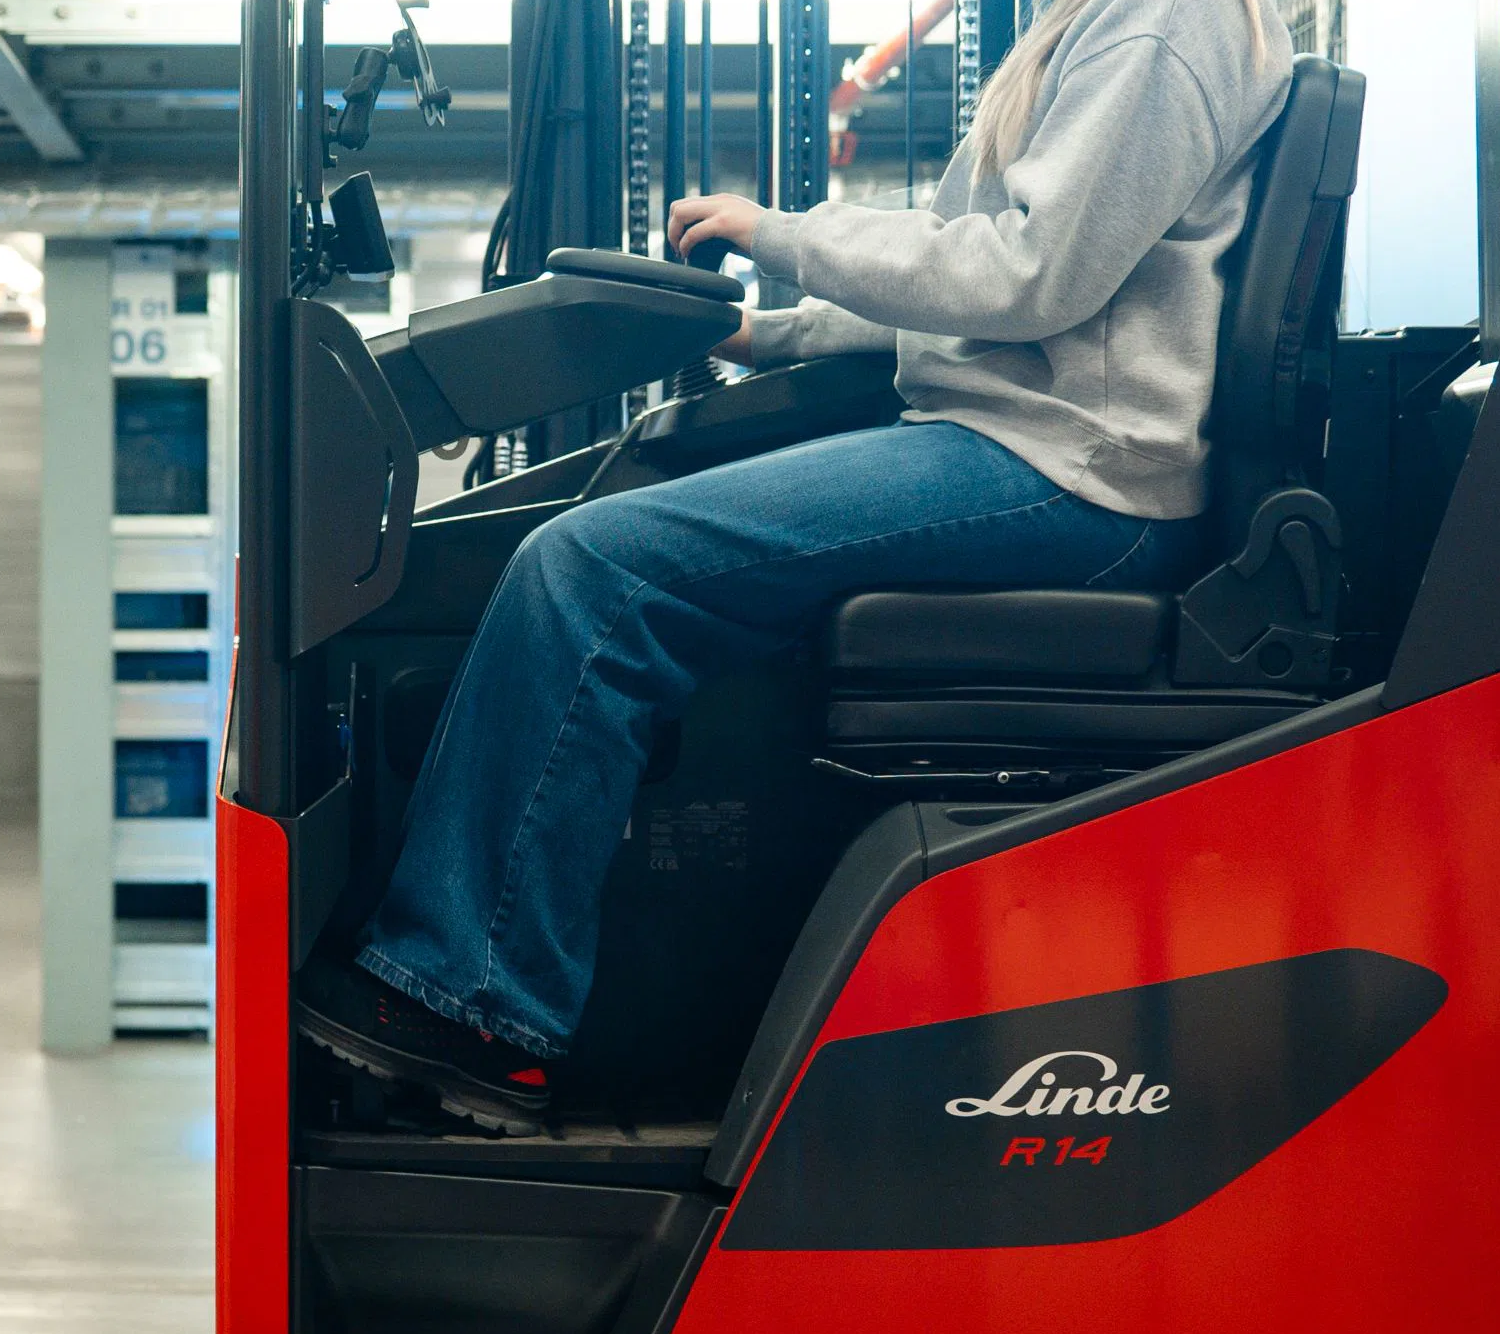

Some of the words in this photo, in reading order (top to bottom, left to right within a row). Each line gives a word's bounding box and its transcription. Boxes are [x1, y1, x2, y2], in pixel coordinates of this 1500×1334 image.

[110, 330, 166, 364] 06
[945, 1051, 1171, 1118] Linde
[1000, 1137, 1047, 1167] R
[1056, 1137, 1113, 1167] 14
